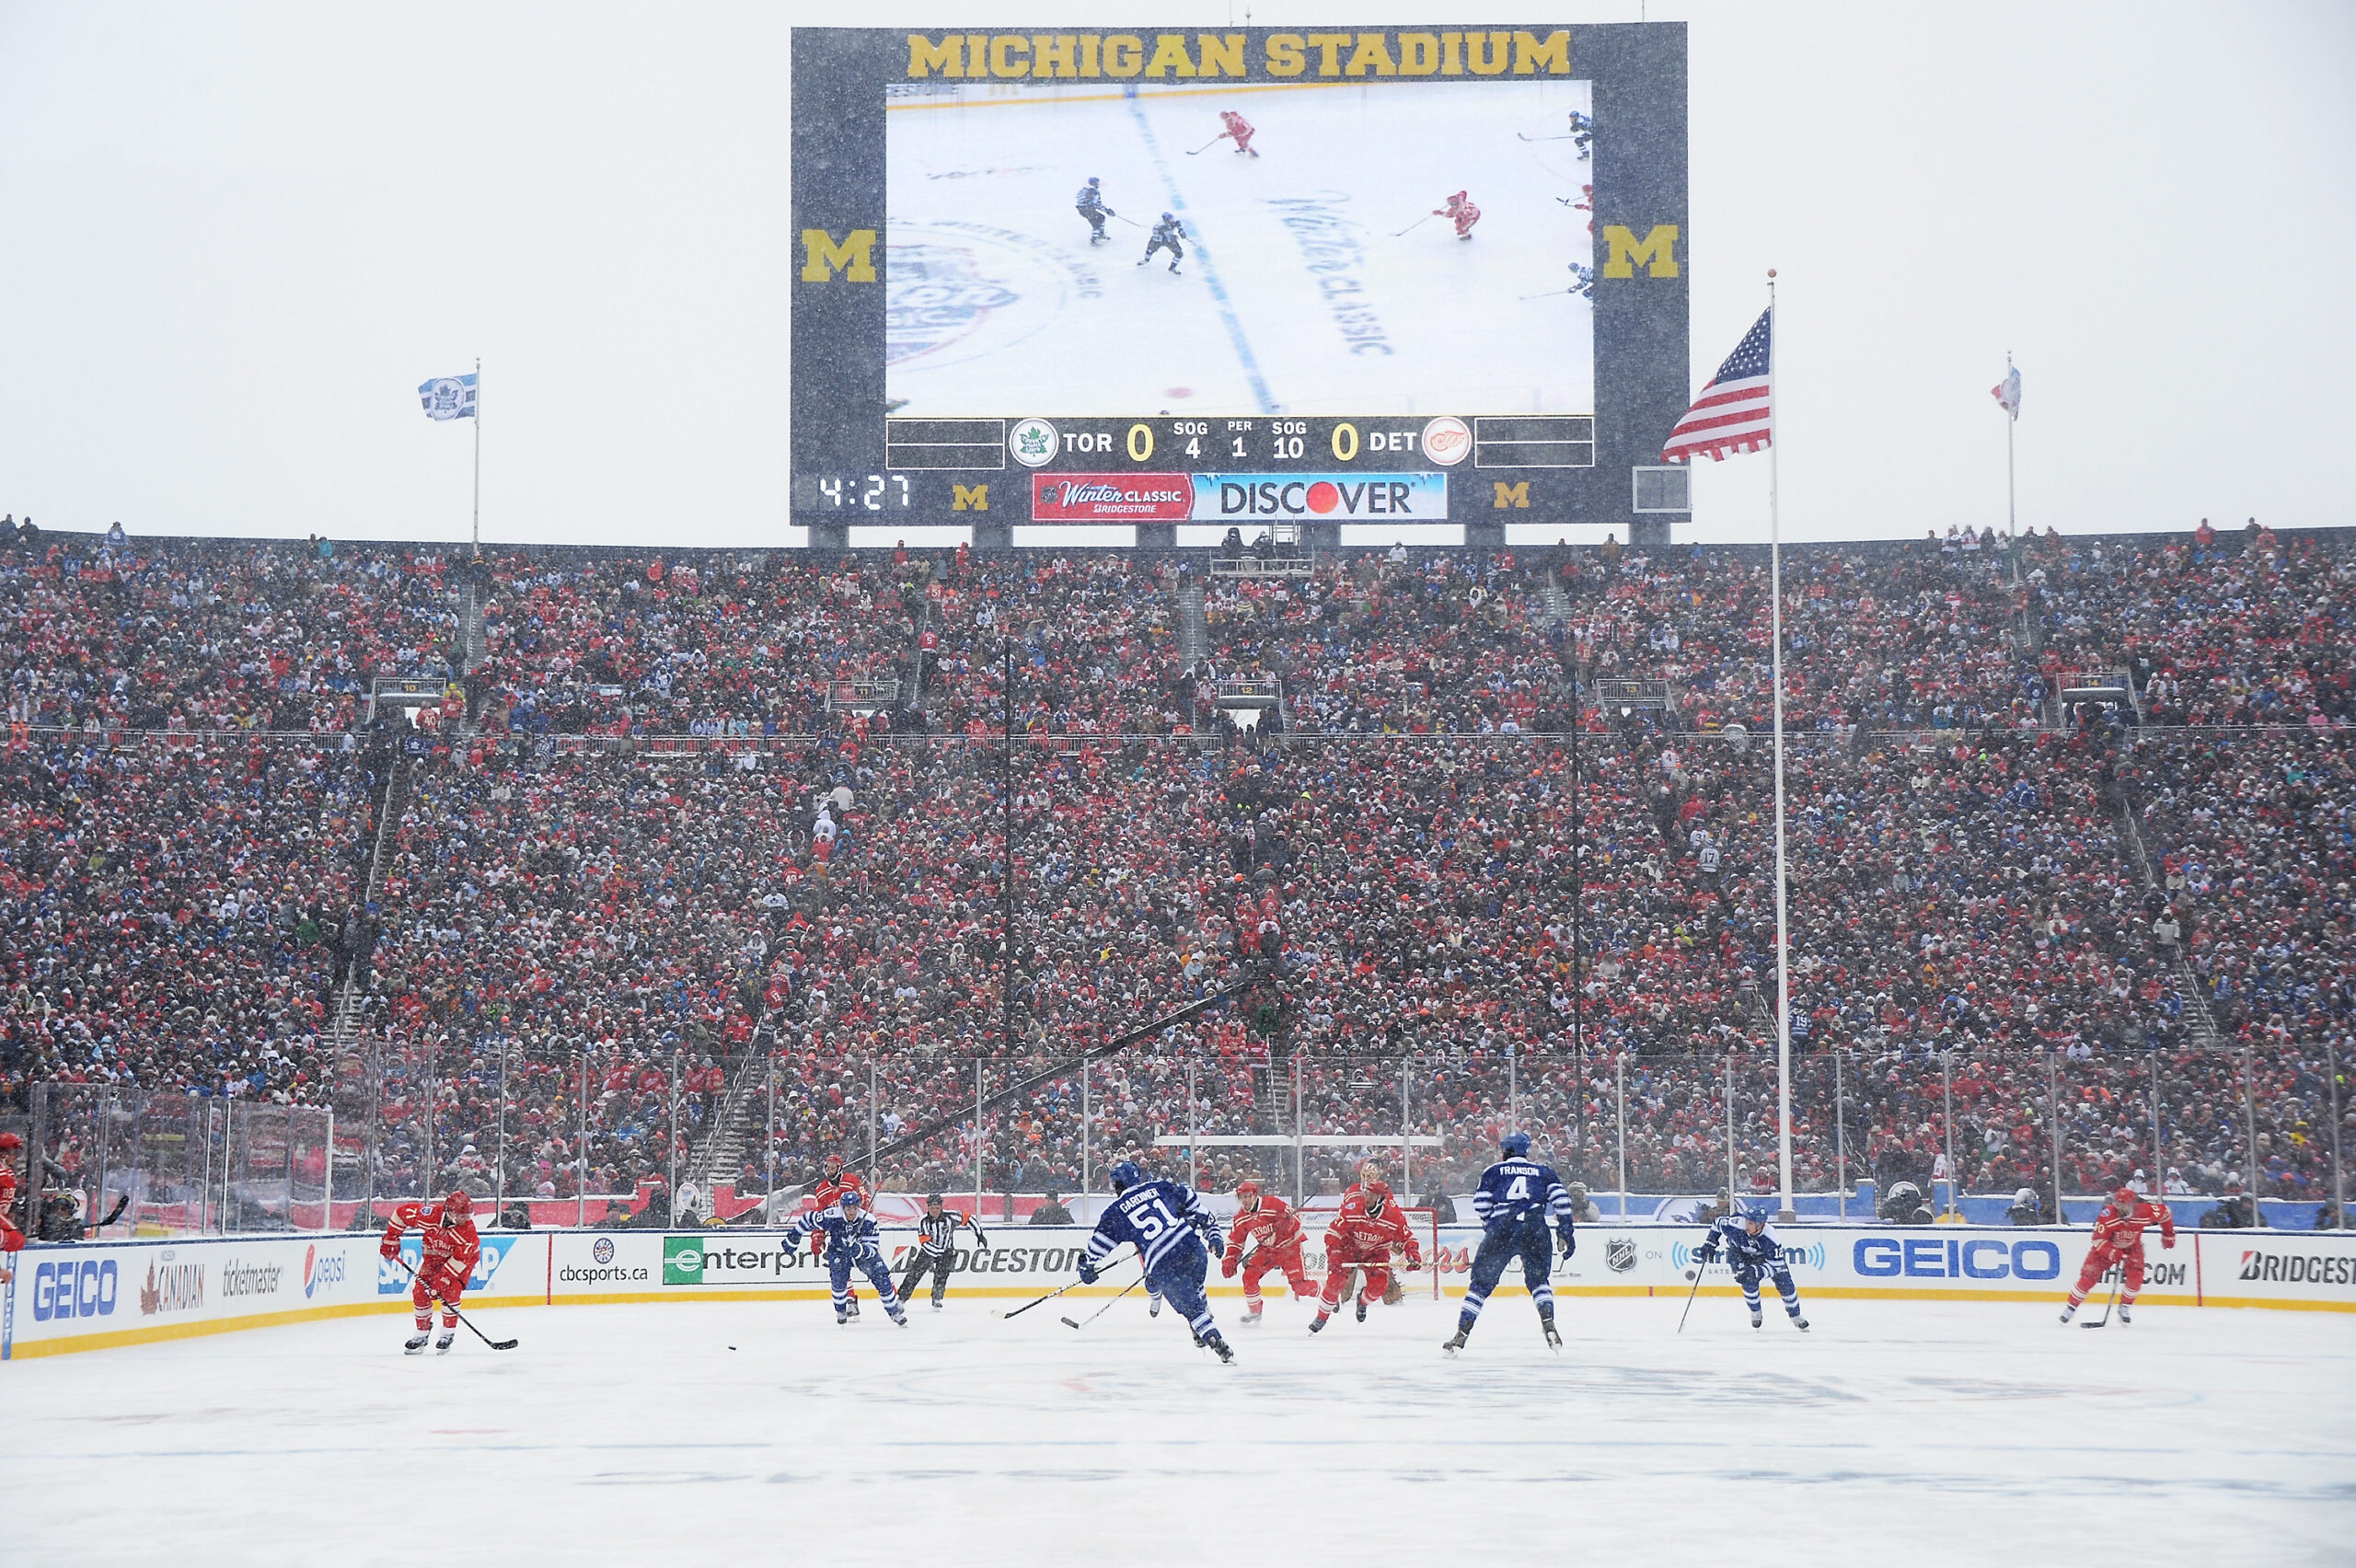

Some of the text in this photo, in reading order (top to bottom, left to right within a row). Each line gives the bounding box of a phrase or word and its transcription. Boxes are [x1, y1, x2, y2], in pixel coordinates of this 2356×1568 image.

[907, 30, 1571, 77] MICHIGAN STADIUM
[802, 229, 876, 282] M
[1603, 224, 1680, 279] M
[1173, 421, 1208, 435] SOG
[1228, 421, 1253, 432] PER
[1272, 421, 1307, 435] SOG
[1062, 432, 1113, 453] TOR
[1126, 423, 1155, 462] 0
[1184, 437, 1201, 459] 4
[1231, 436, 1247, 457] 1
[1273, 437, 1305, 459] 10
[1332, 422, 1359, 461] 0
[1369, 432, 1417, 451] DET
[820, 475, 908, 511] 4:27
[952, 484, 988, 511] M
[1058, 479, 1124, 508] Winter
[1124, 490, 1182, 502] CLASSIC
[1220, 480, 1412, 515] DISCOVER
[1494, 481, 1530, 508] M
[1093, 504, 1157, 513] BRIDGESTONE
[424, 715, 436, 726] 40
[1704, 852, 1715, 863] 17
[1796, 1015, 1807, 1028] 19
[1499, 1166, 1540, 1177] FRANSON
[1119, 1187, 1161, 1214] GARDINER
[1506, 1175, 1530, 1201] 4
[1126, 1197, 1179, 1240] 51
[664, 1247, 829, 1275] enterpris
[890, 1245, 1090, 1274] BDGESTON
[1611, 1248, 1662, 1265] NHL ON
[1853, 1238, 2061, 1280] GEICO
[223, 1258, 281, 1297] ticketmaster
[315, 1250, 346, 1291] pepsi
[560, 1264, 648, 1285] cbcsports.ca
[4, 1252, 17, 1343] Rebok
[33, 1259, 118, 1322] GEICO
[158, 1263, 205, 1311] CANADIAN
